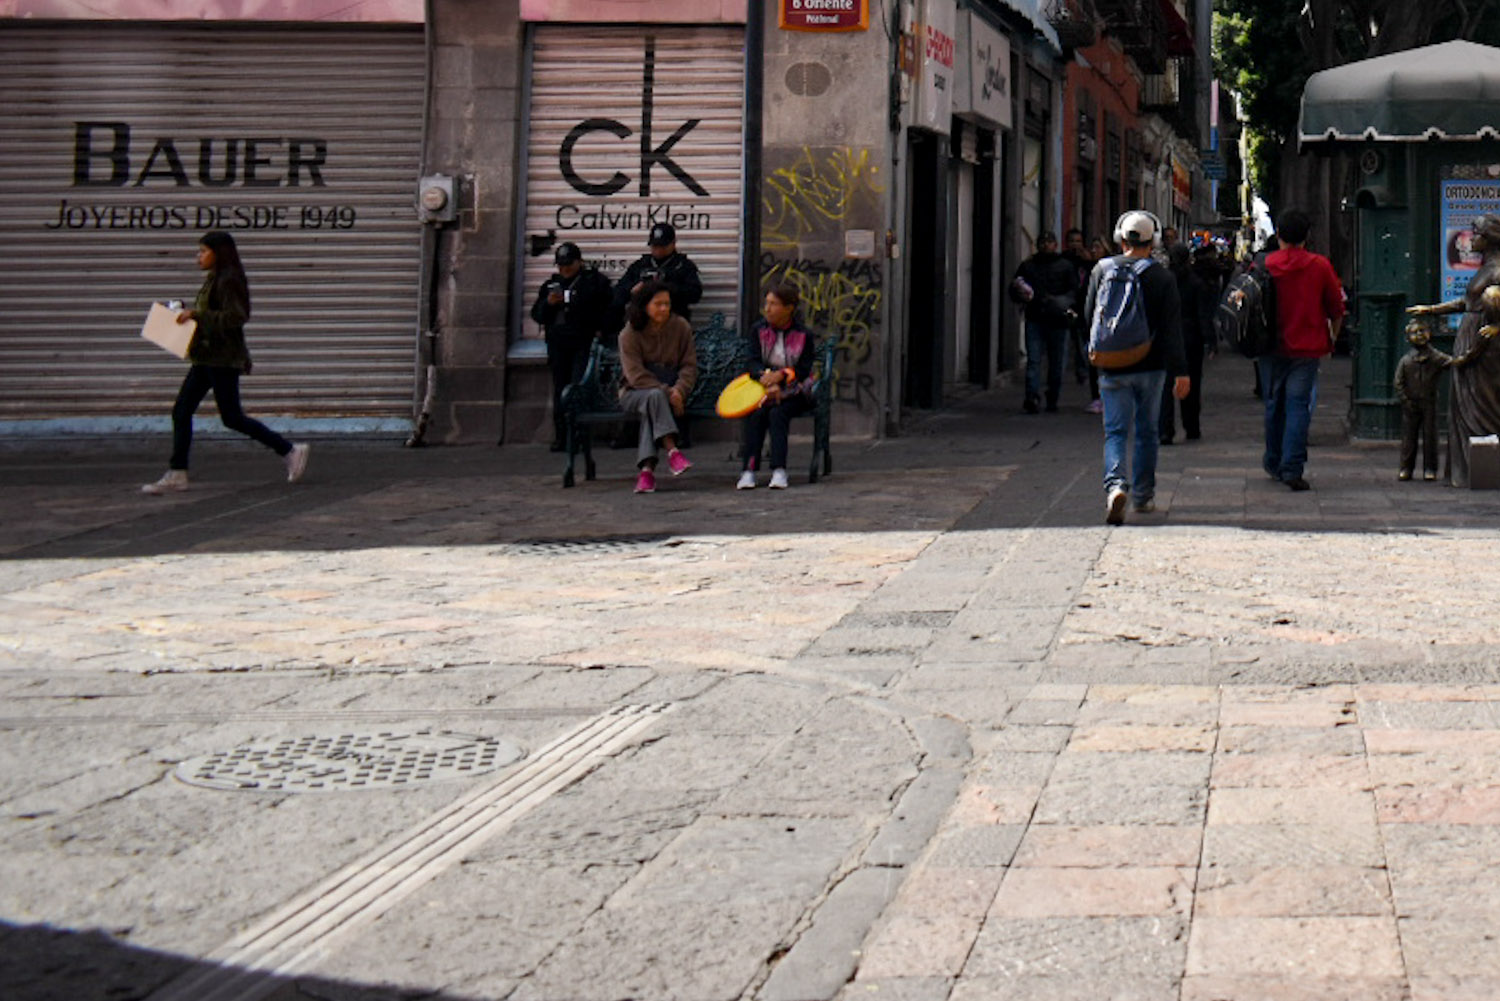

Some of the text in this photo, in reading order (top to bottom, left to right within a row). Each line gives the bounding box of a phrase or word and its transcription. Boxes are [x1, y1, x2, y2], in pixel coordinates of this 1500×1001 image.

[72, 121, 328, 187] BAUER
[43, 200, 357, 230] JOYEROS DESDE 1949
[556, 204, 711, 230] Calvin Klein
[583, 254, 628, 272] wiss
